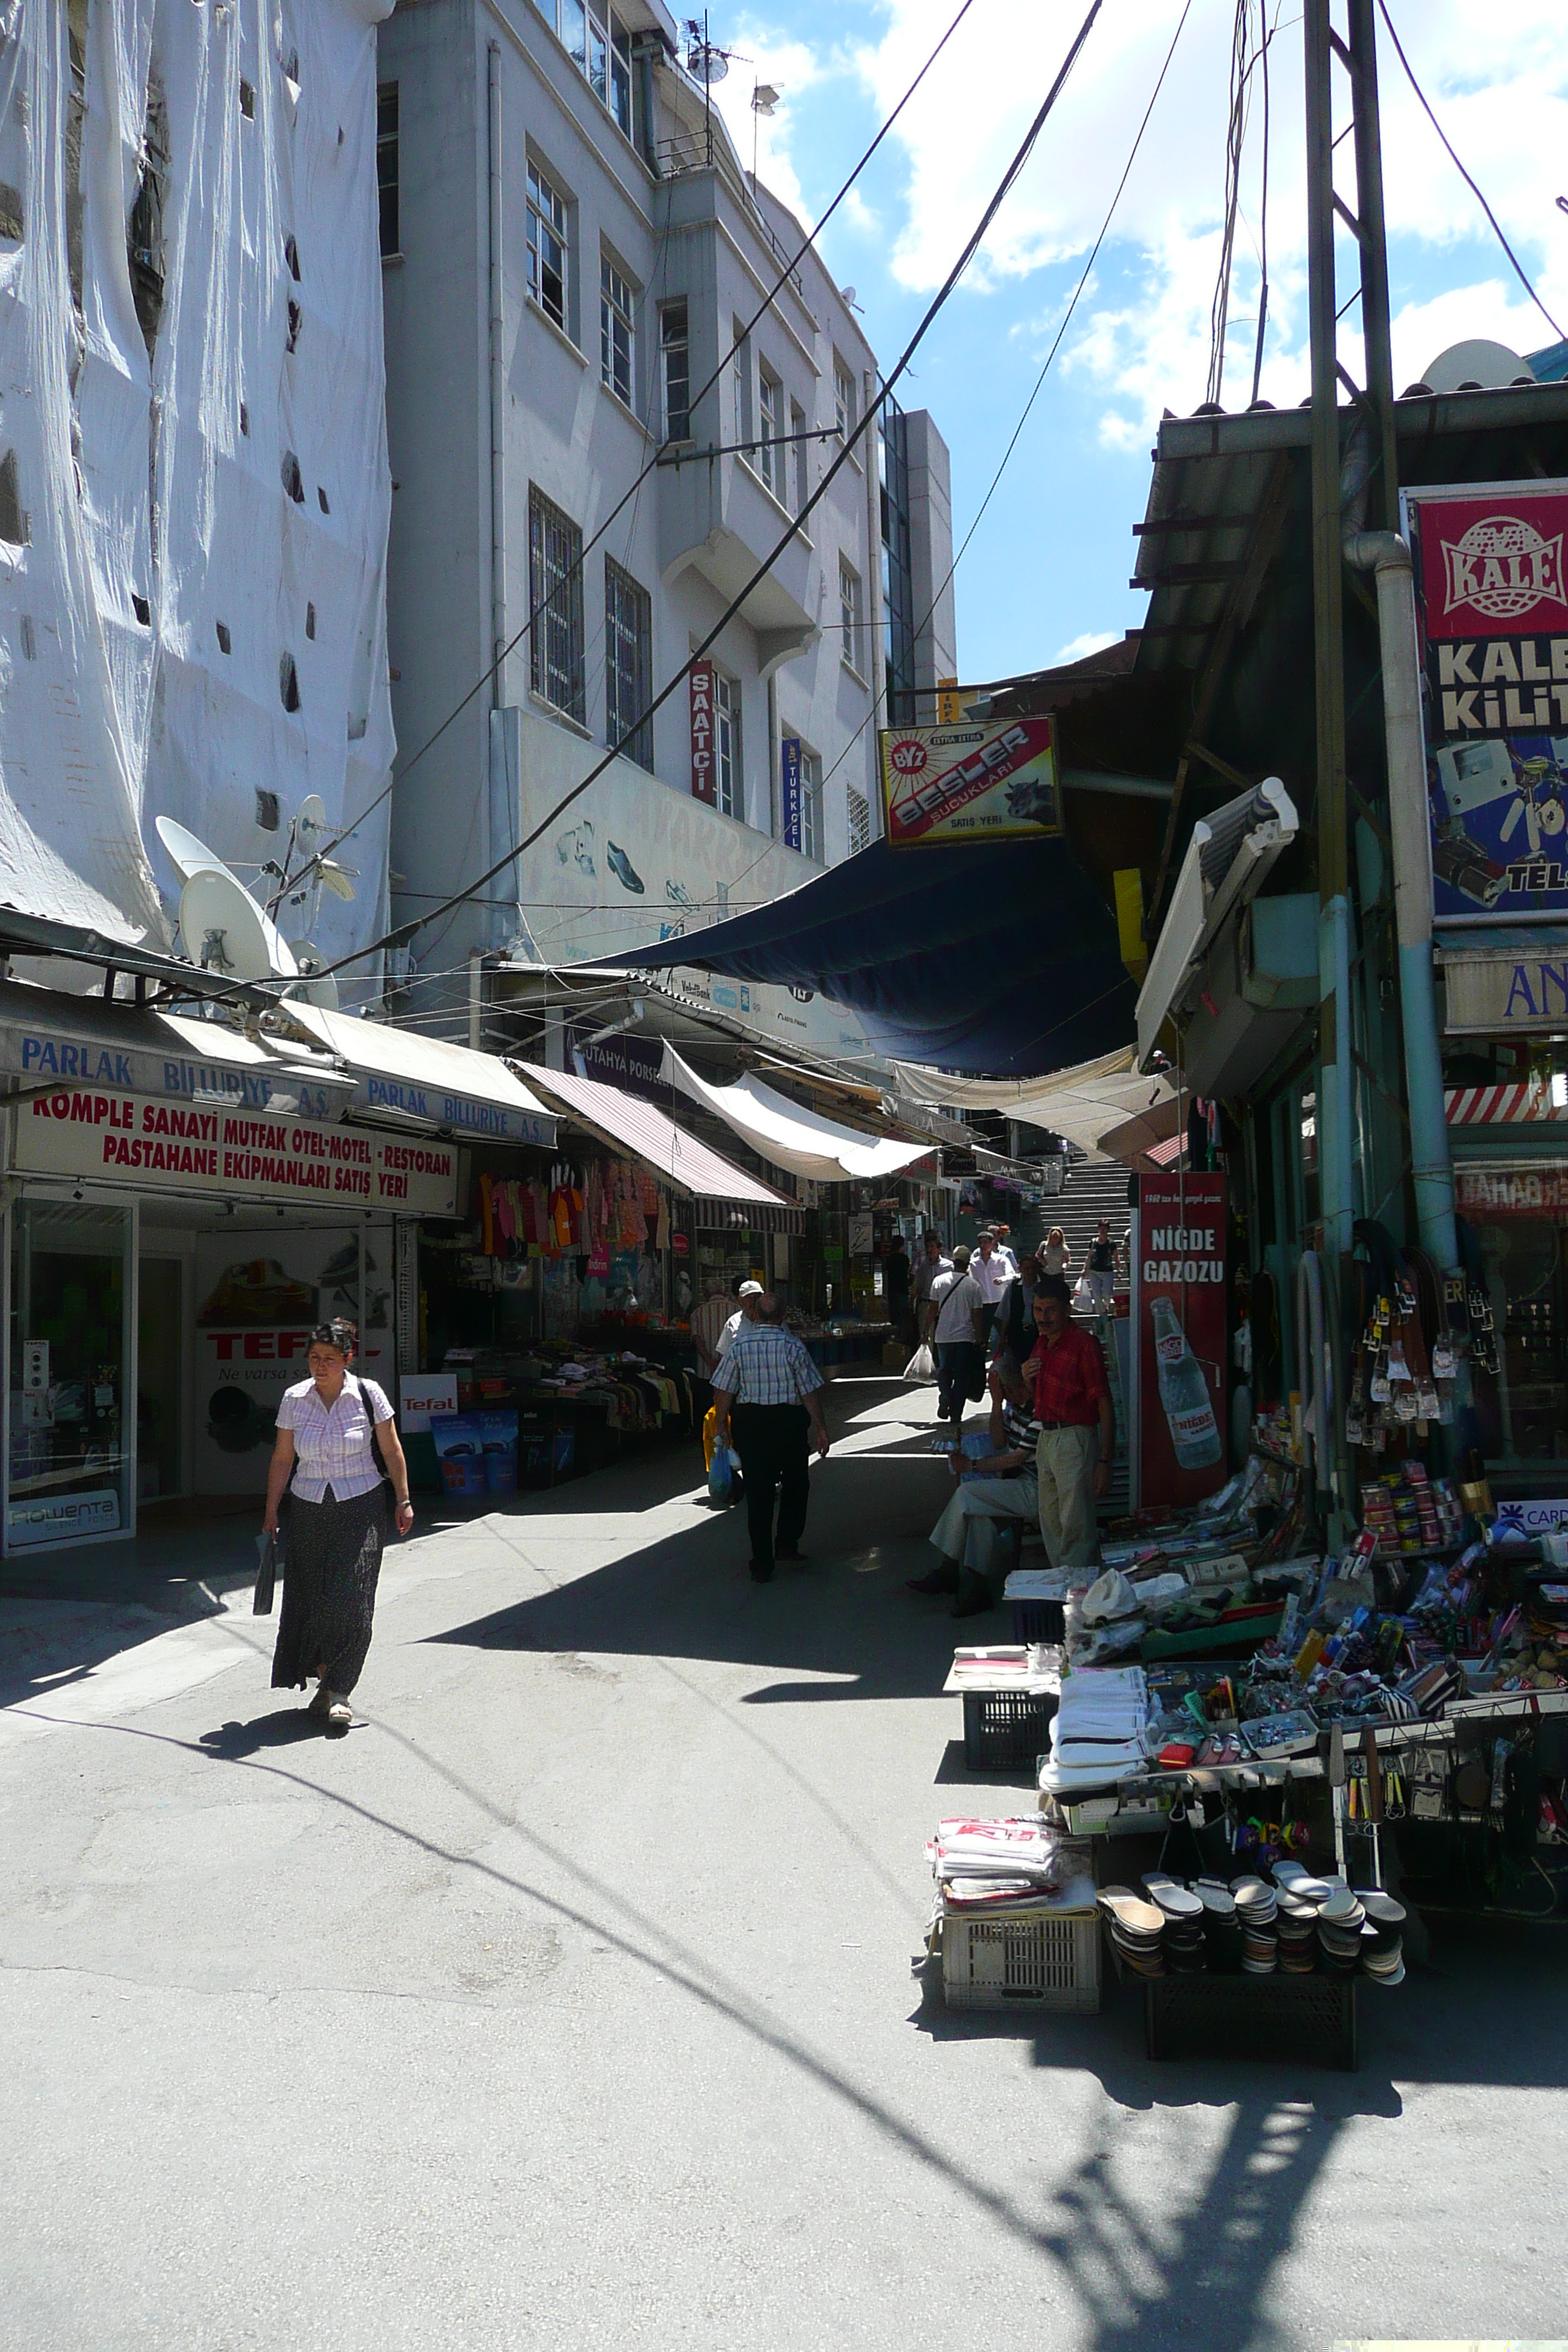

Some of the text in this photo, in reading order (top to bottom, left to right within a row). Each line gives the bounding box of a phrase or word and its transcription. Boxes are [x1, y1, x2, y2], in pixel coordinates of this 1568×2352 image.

[1450, 546, 1557, 600] KALE
[693, 674, 709, 791] SAATÇİ
[894, 747, 925, 768] BYZ
[895, 726, 1029, 826] BESLER
[930, 761, 1013, 823] SUCUKLARI
[22, 1038, 132, 1085] PARLAK
[142, 1105, 218, 1142] SANAYİ
[223, 1118, 287, 1152] MUTFAK
[368, 1079, 429, 1115] PARLAK
[444, 1096, 508, 1134] BİLLURİYE
[103, 1135, 408, 1199] PASTAHANE EKİPMANLARI SATIŞ YERİ
[1151, 1224, 1215, 1251] NİĞDE
[1143, 1260, 1224, 1283] GAZOZU
[244, 1369, 287, 1379] varsa
[403, 1398, 456, 1411] Tefal
